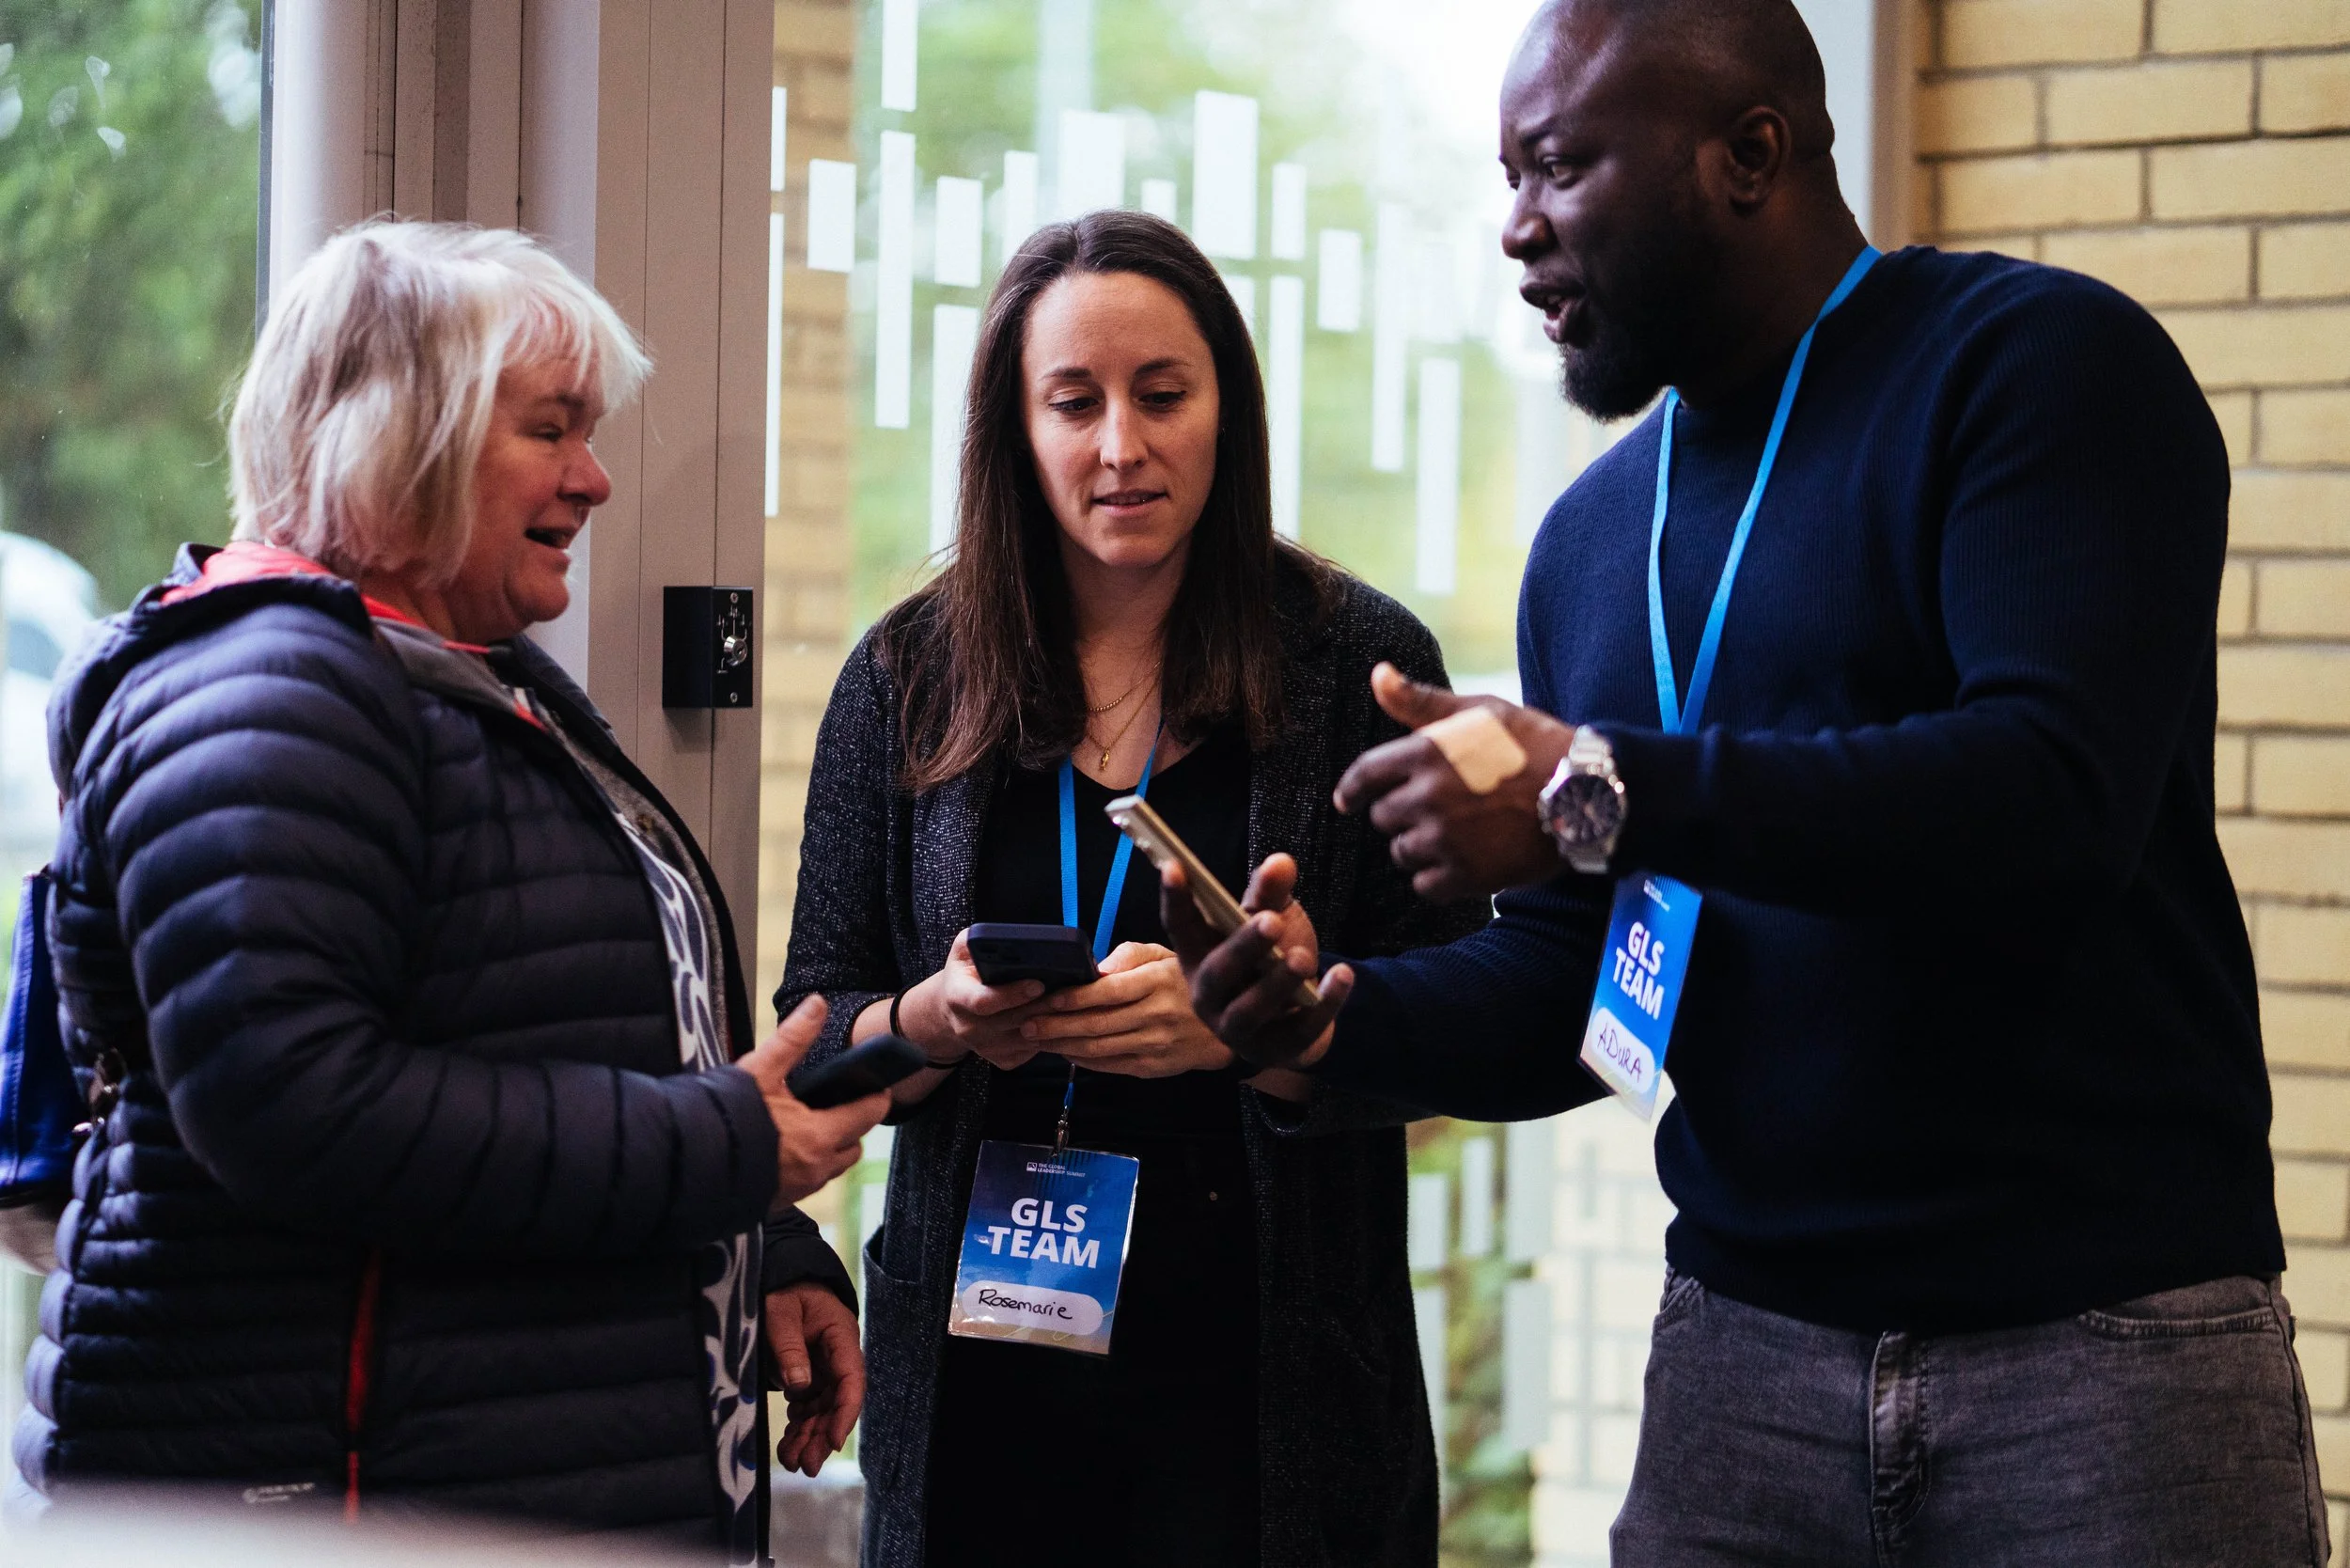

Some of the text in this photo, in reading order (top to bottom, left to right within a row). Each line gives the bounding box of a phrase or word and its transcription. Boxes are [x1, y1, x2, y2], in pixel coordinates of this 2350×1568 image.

[1627, 921, 1665, 978] GLS
[1613, 948, 1665, 1020] TEAM
[1597, 1022, 1642, 1083] ADURA
[1010, 1198, 1088, 1233] GLS
[987, 1226, 1100, 1269] TEAM
[978, 1289, 1073, 1320] Rosemarie
